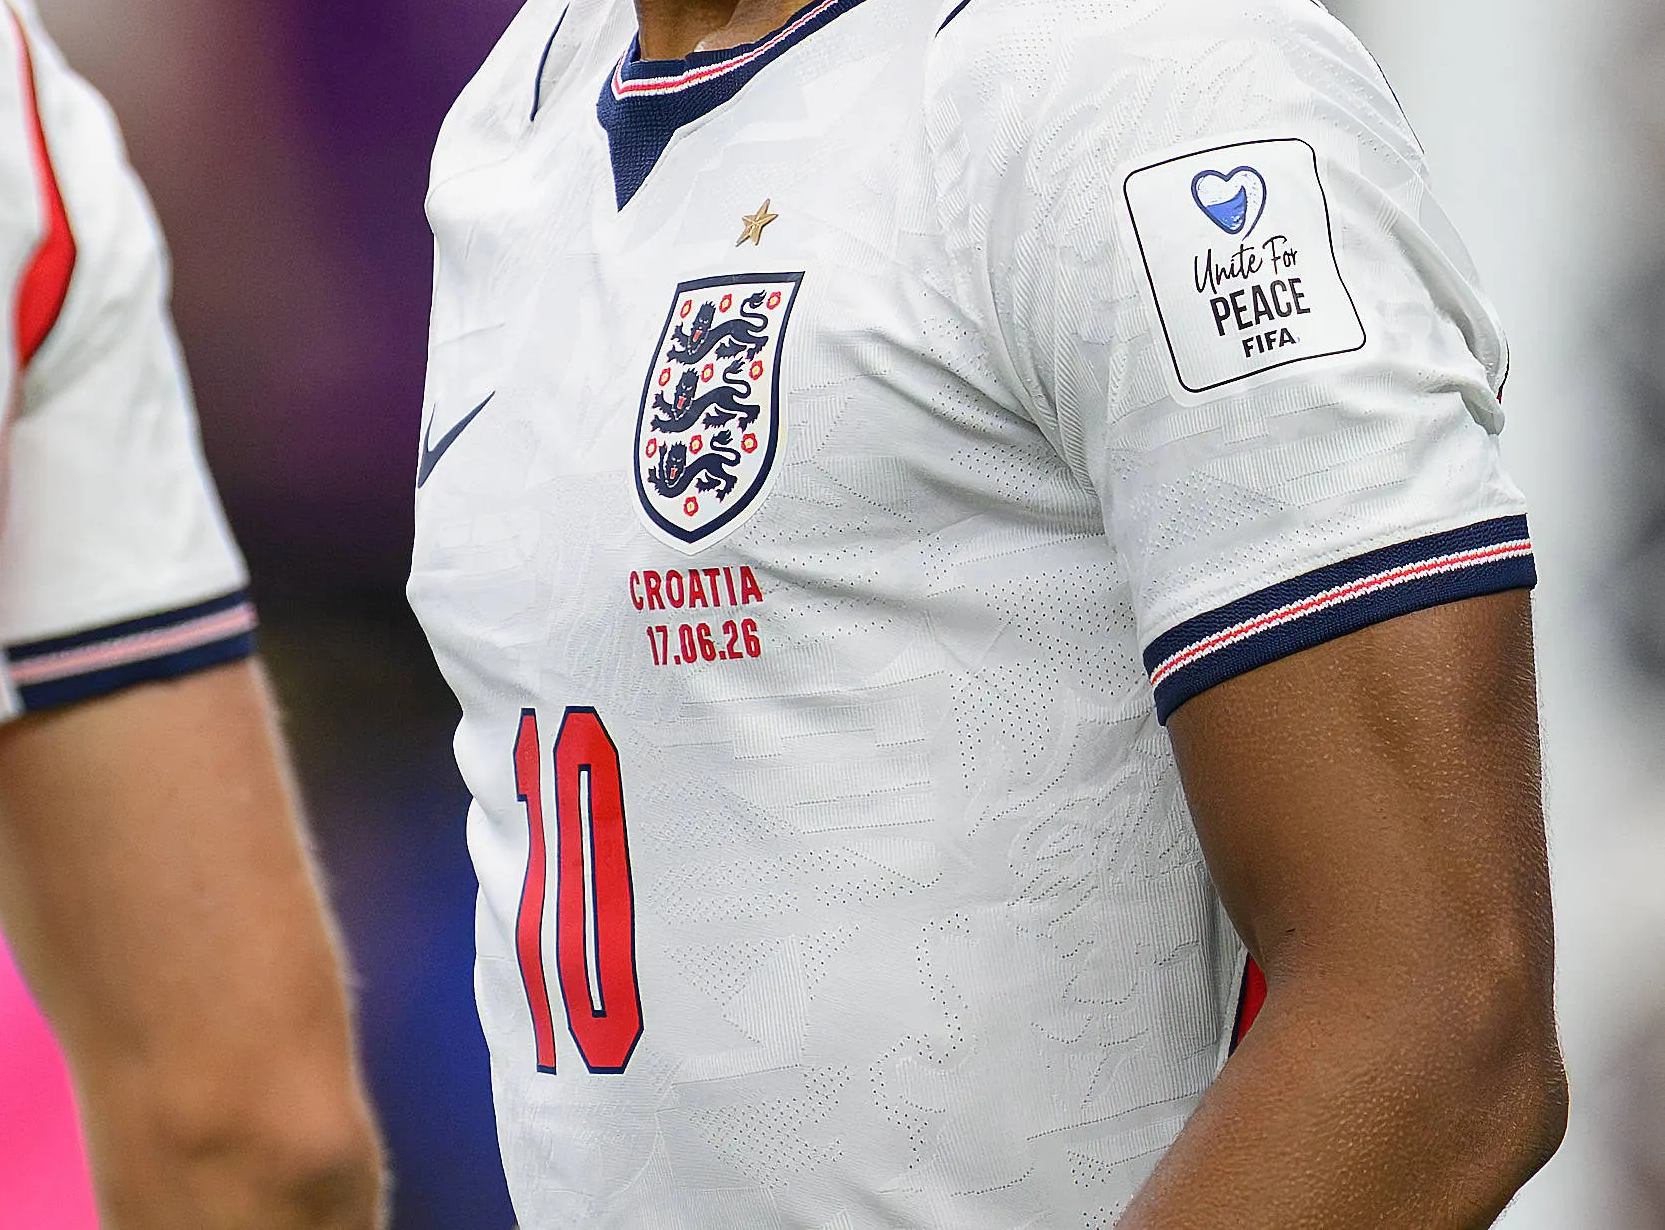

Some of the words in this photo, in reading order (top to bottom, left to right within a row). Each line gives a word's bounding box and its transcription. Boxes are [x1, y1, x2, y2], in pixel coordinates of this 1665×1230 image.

[1194, 243, 1263, 294] Unite
[1262, 235, 1298, 275] For
[1210, 278, 1311, 336] PEACE
[1242, 327, 1297, 358] FIFA
[629, 565, 764, 611] CROATIA
[646, 618, 762, 666] 17.06.26
[513, 706, 645, 1076] 10
